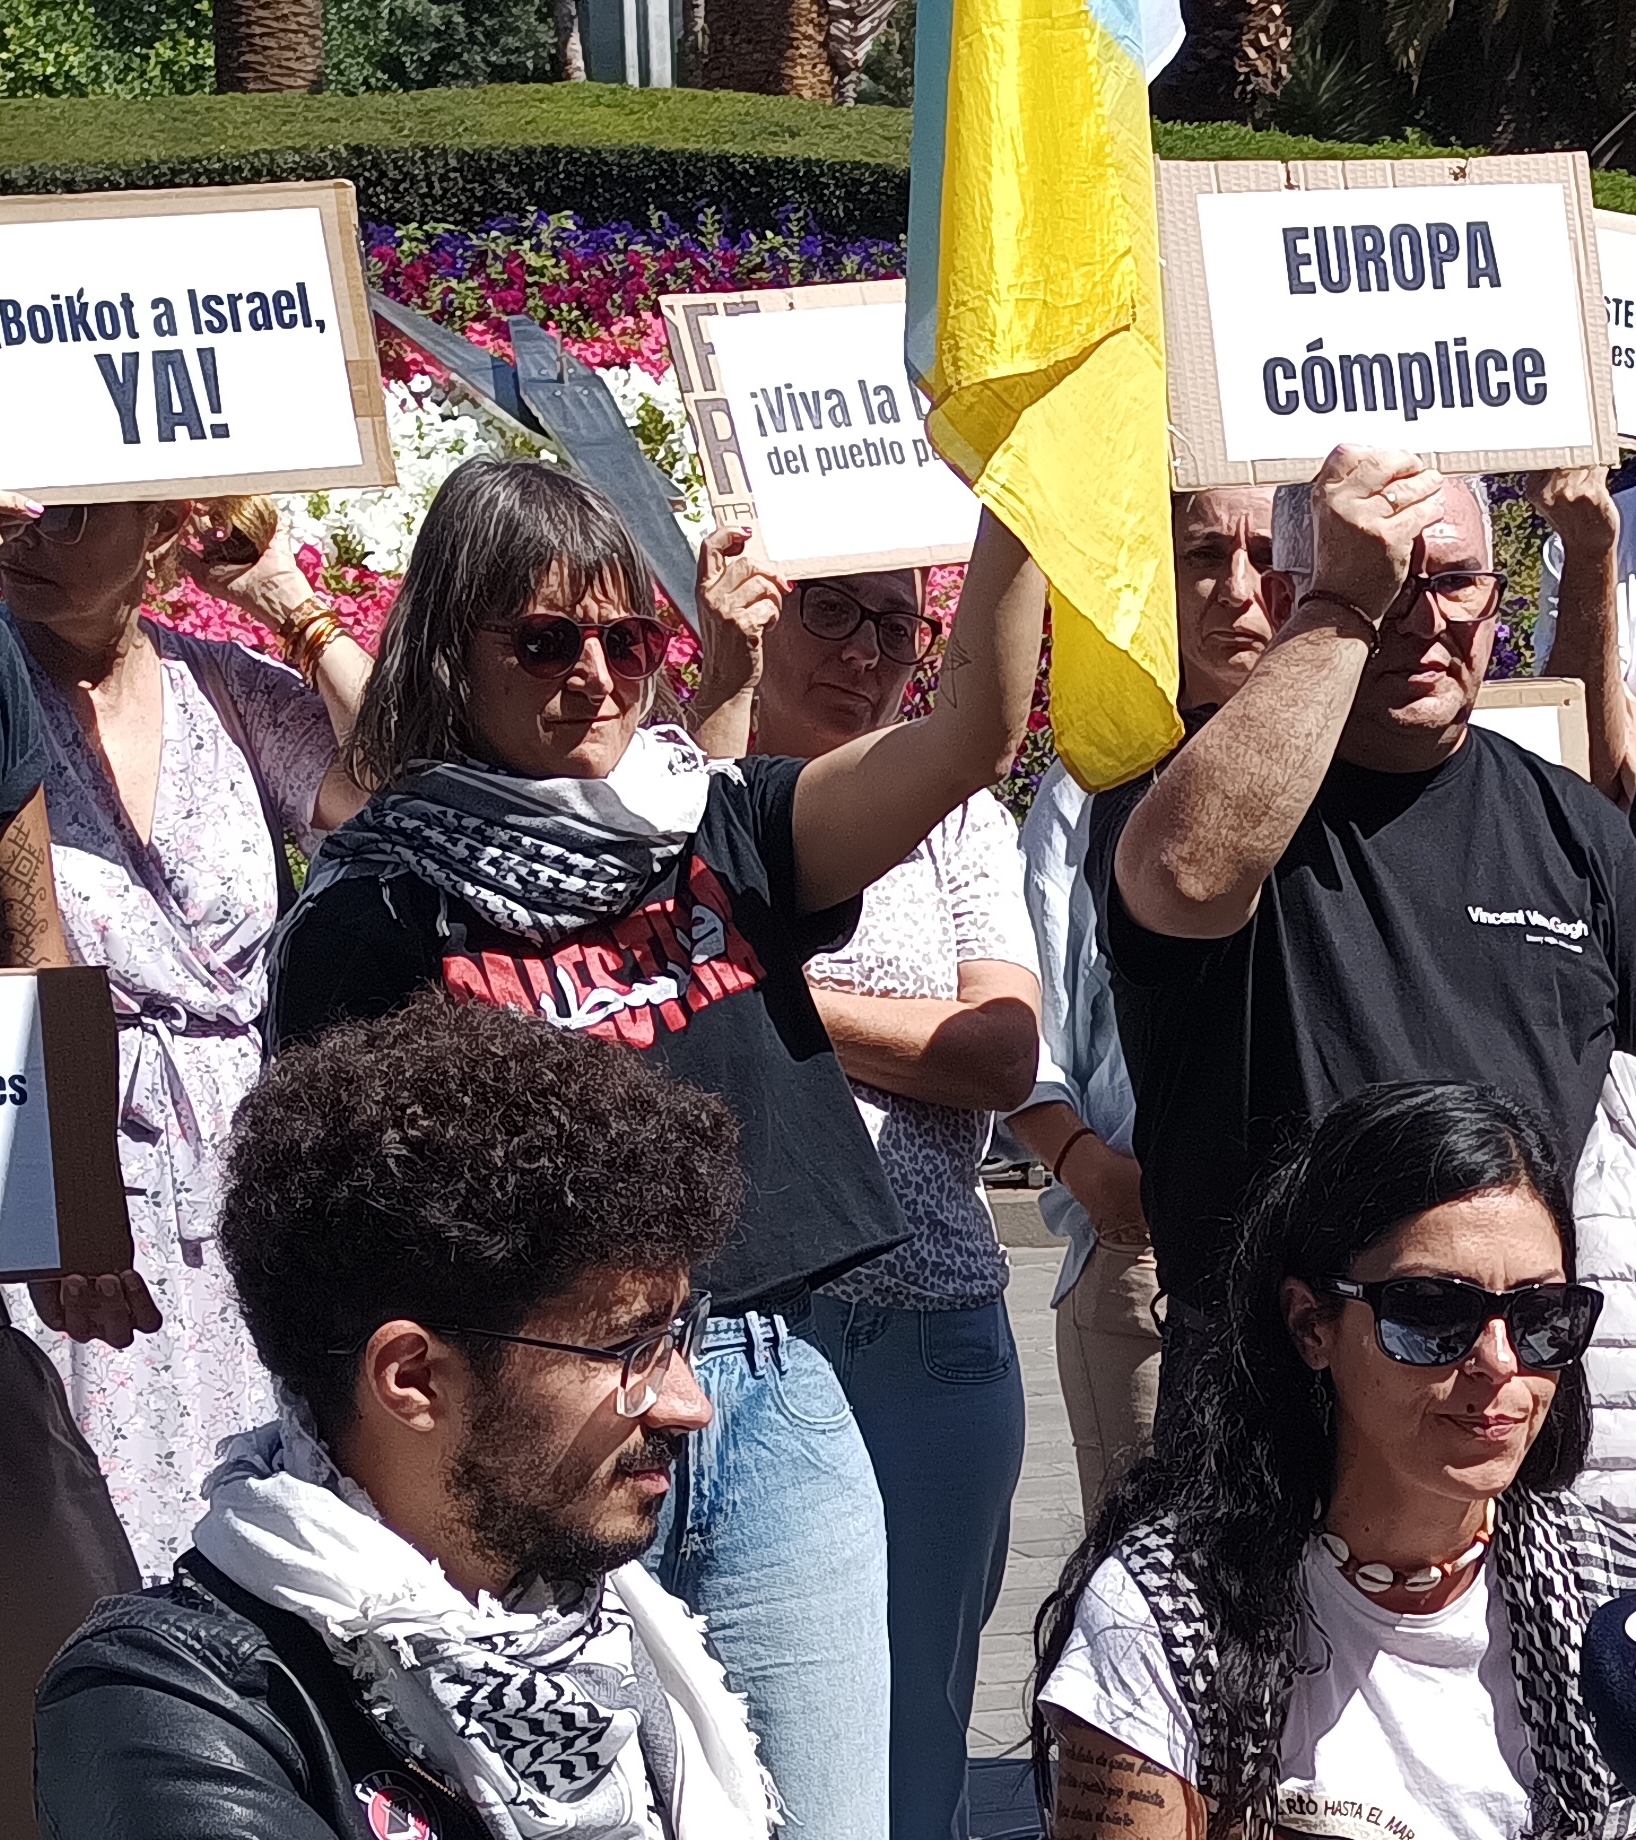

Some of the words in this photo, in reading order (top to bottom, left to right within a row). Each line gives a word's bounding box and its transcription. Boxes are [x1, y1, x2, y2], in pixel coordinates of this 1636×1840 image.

[1282, 221, 1502, 295] EUROPA
[151, 297, 178, 337] a
[187, 282, 326, 335] Israel,
[94, 347, 230, 444] YA!
[1263, 337, 1548, 422] cómplice
[750, 383, 852, 437] ¡Viva
[858, 380, 901, 425] la
[767, 444, 809, 475] del
[815, 437, 906, 476] pueblo
[912, 438, 941, 467] p
[1324, 1800, 1363, 1819] HASTA
[1366, 1807, 1384, 1826] EL
